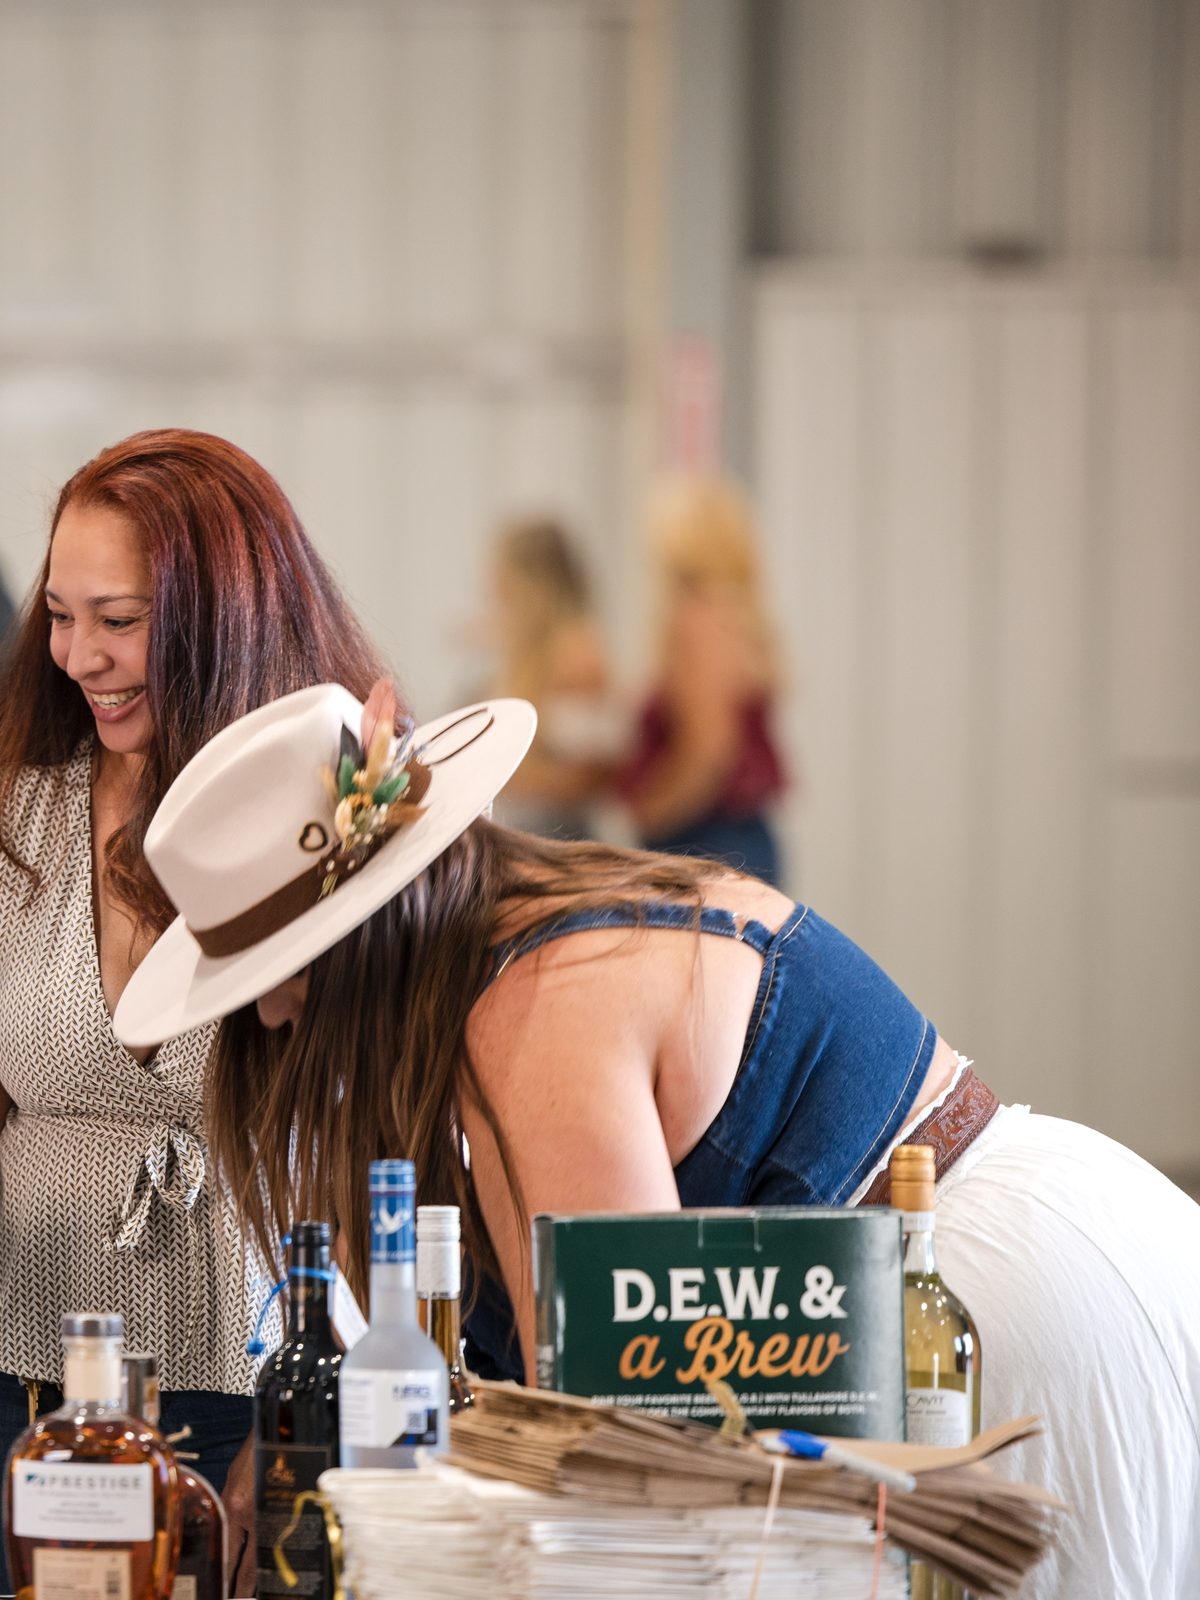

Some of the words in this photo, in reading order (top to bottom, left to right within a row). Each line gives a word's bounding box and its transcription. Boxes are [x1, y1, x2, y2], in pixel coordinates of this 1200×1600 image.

[612, 1266, 789, 1322] D.E.W.
[800, 1264, 848, 1320] &
[619, 1334, 666, 1380] a
[675, 1317, 850, 1385] Brew
[616, 1393, 643, 1406] YOUR
[644, 1393, 692, 1405] FAVORITE
[764, 1392, 790, 1403] WITH
[791, 1391, 848, 1403] TULLAMORE
[670, 1406, 689, 1417] THE
[777, 1405, 821, 1416] FLAVORS
[822, 1404, 836, 1415] OF
[48, 1475, 142, 1490] PRESTIGE
